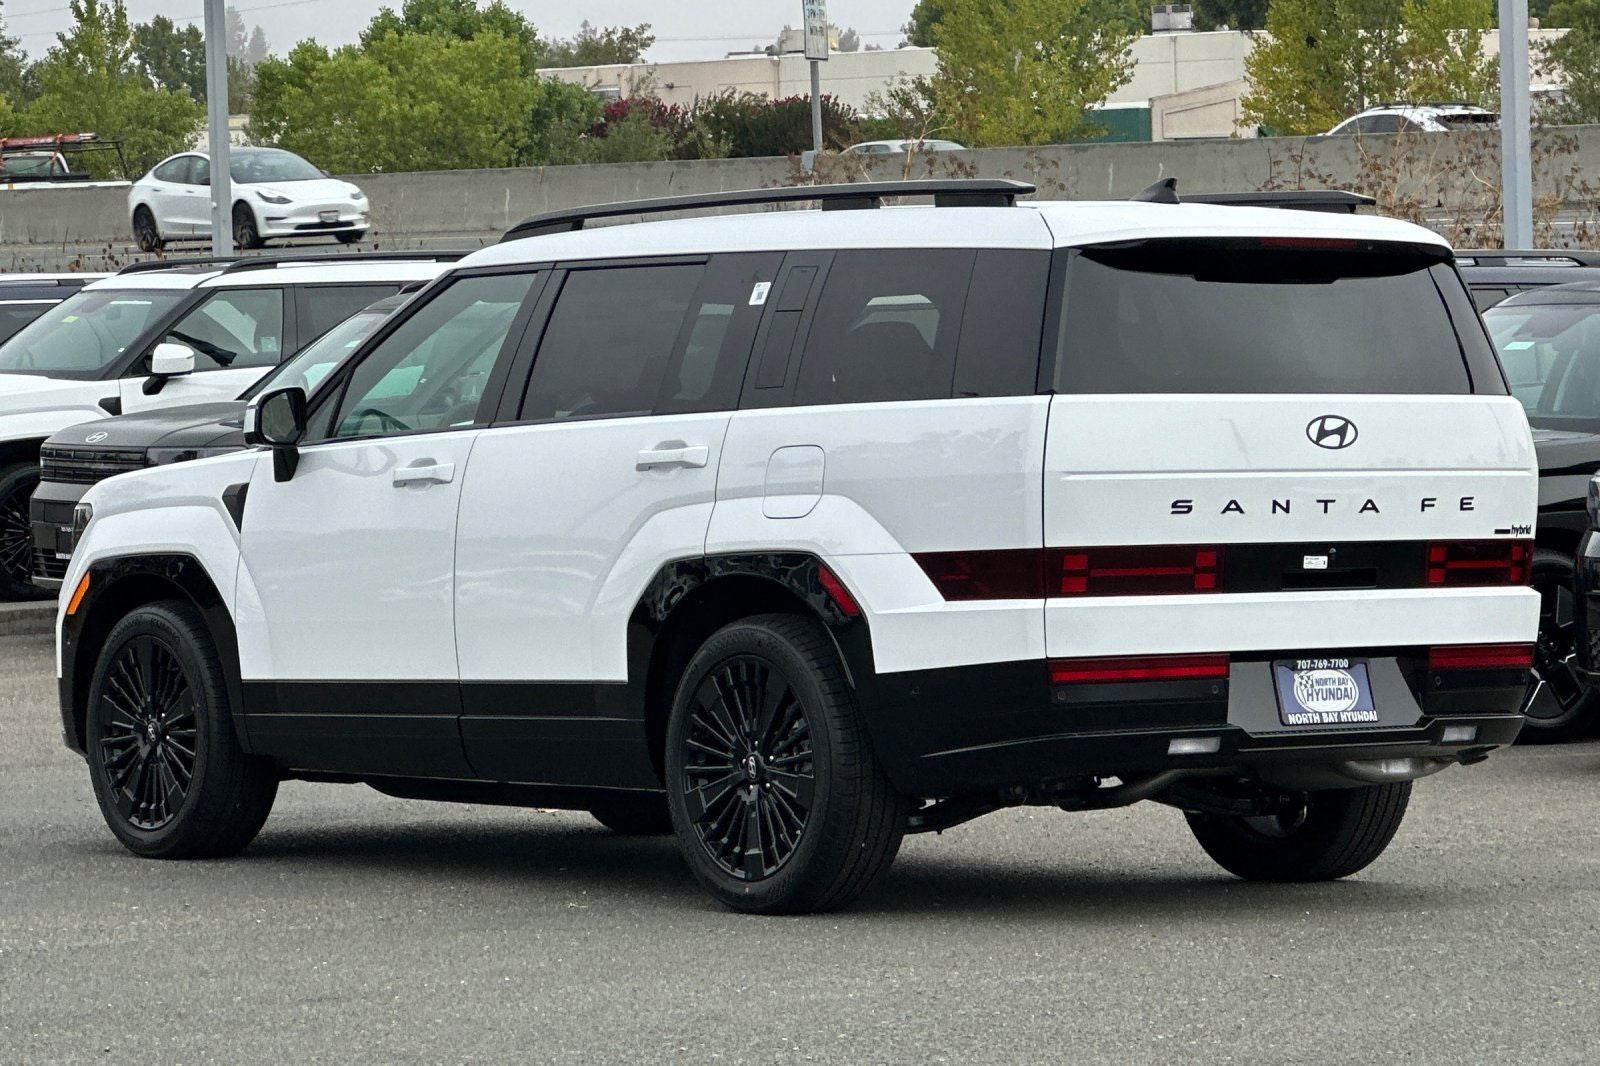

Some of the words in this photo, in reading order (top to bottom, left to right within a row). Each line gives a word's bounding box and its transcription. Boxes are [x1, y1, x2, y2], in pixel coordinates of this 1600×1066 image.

[1170, 498, 1380, 514] SANTA
[1420, 496, 1475, 512] FE
[1511, 524, 1532, 538] hybrid
[1297, 659, 1349, 669] 707-769-7700
[1315, 677, 1336, 686] NORTH
[1337, 677, 1349, 686] BAY
[1306, 688, 1353, 701] HYUNDAI
[1288, 713, 1320, 725] NORTH
[1321, 711, 1339, 723] BAY
[1340, 710, 1378, 722] HYUNDAI
